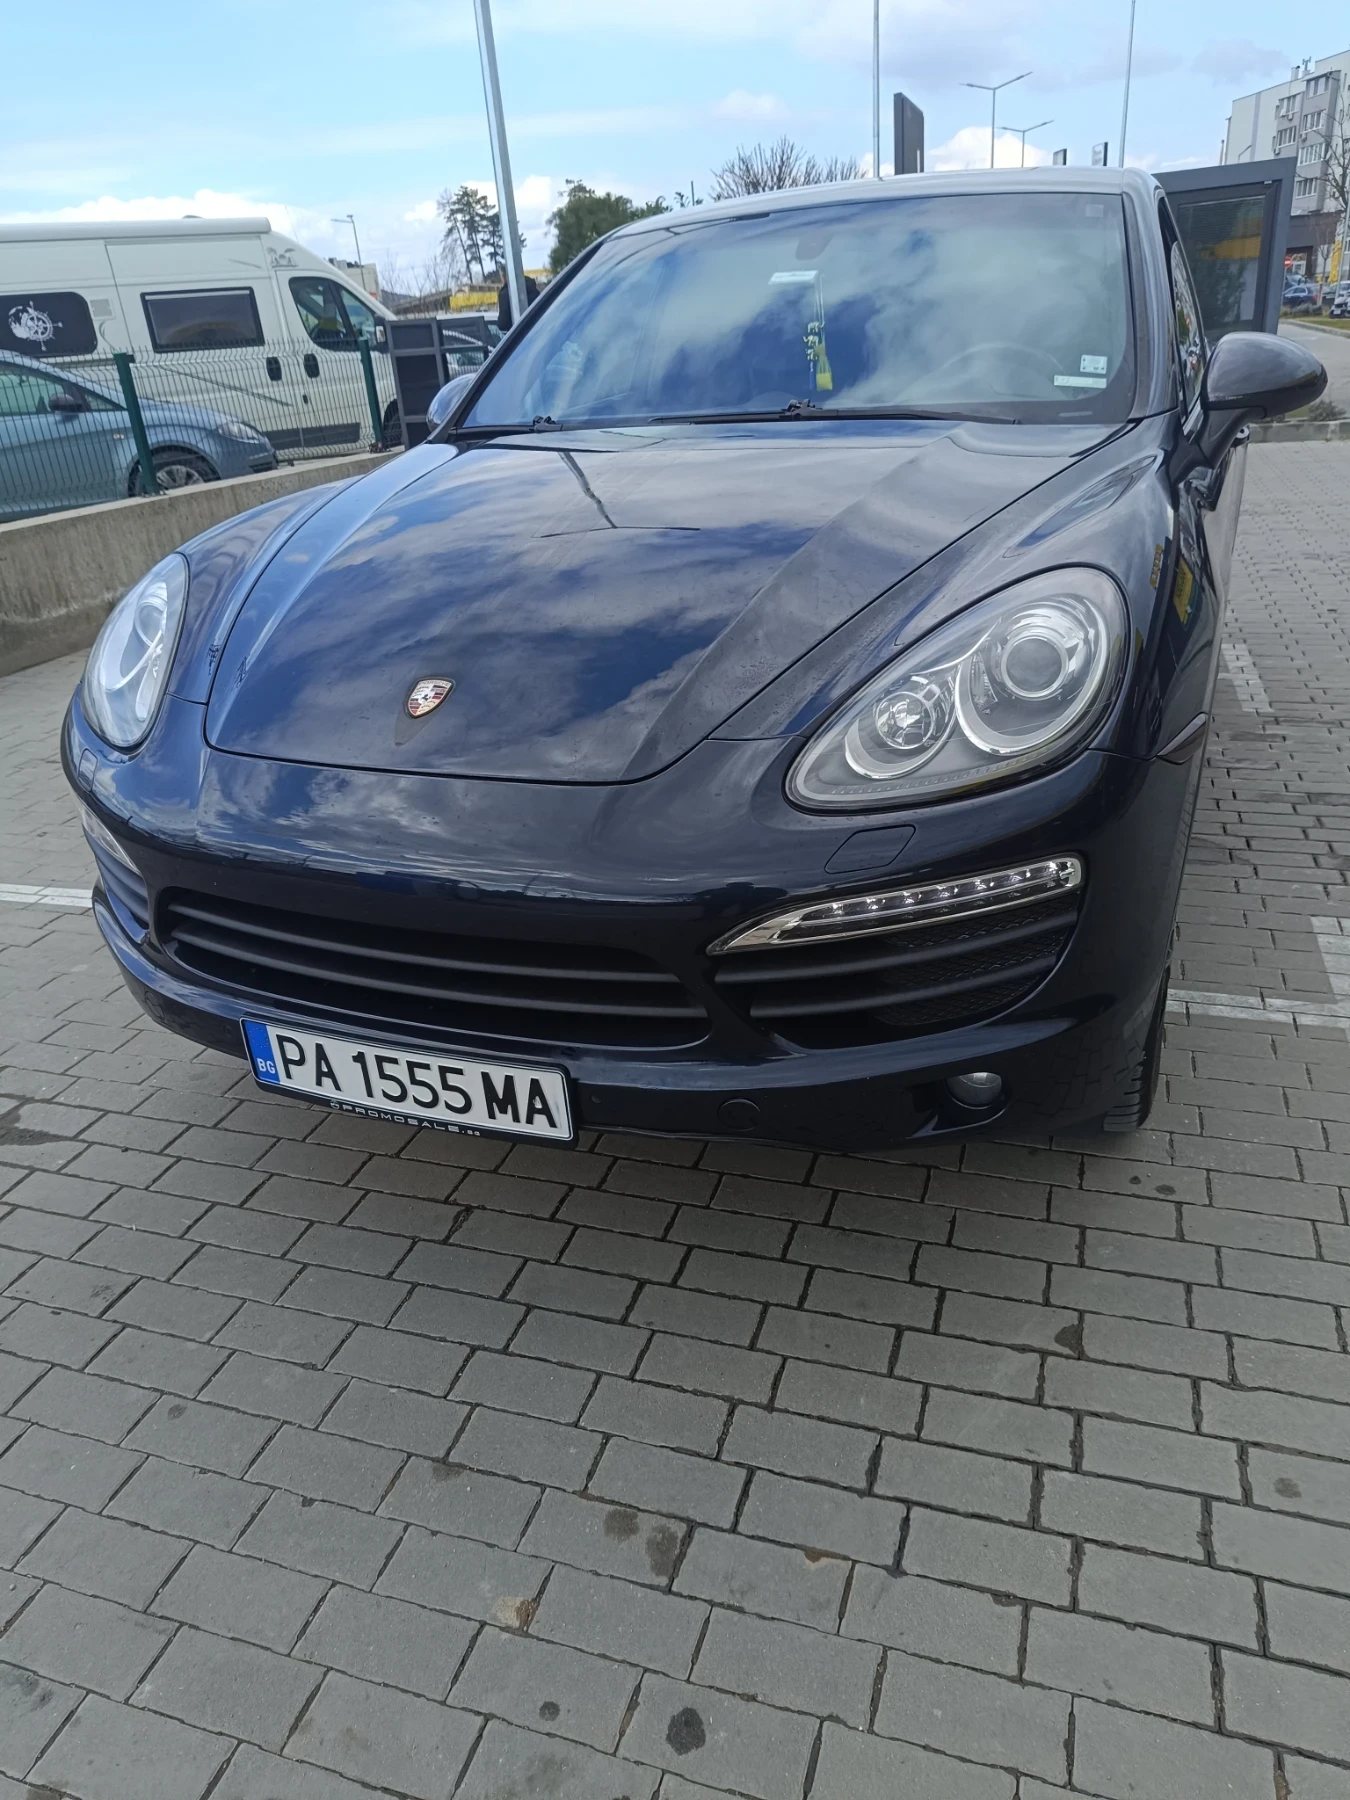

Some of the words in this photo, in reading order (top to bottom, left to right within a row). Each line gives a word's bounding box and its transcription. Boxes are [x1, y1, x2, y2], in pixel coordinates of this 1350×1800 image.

[257, 1058, 276, 1075] BG
[275, 1033, 343, 1092] PA
[351, 1050, 473, 1115] 1555
[481, 1071, 558, 1129] MA
